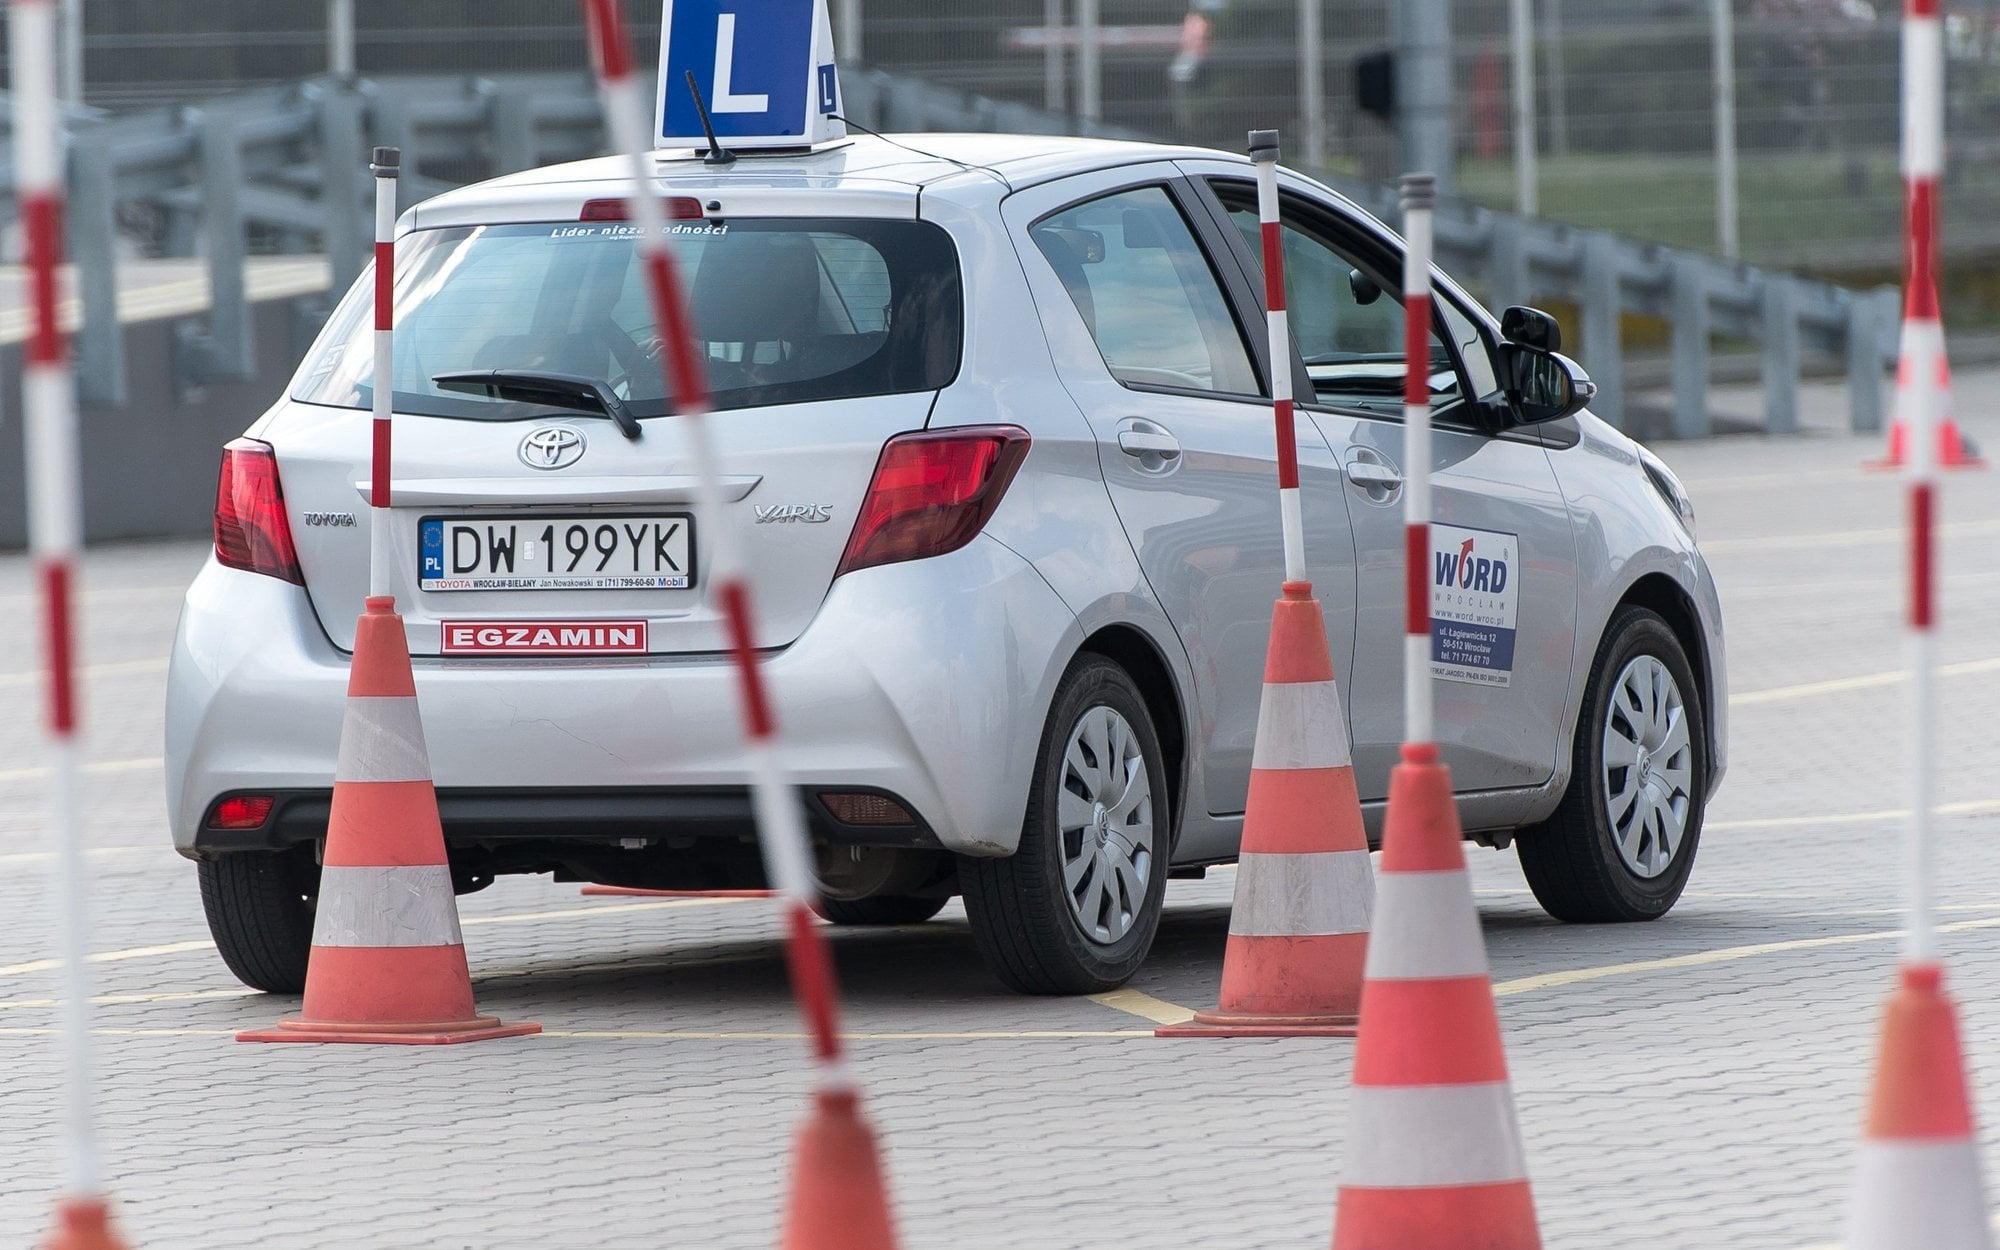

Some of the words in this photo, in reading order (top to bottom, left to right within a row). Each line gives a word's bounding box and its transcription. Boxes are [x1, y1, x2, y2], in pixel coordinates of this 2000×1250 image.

[711, 13, 769, 114] L
[822, 72, 832, 106] L
[550, 227, 596, 238] Lider
[600, 223, 729, 237] niezaodności
[303, 511, 358, 527] TOYOTA
[452, 525, 516, 574] DW
[541, 523, 680, 573] 199YK
[425, 557, 441, 571] PL
[1436, 551, 1507, 594] WORD
[435, 580, 471, 589] TOYOTA
[473, 579, 537, 588] WROCŁAW-BIELANY
[540, 579, 552, 588] Jan
[553, 578, 594, 587] Nowakowski
[604, 577, 619, 588] (71)
[658, 577, 684, 586] Mobil
[1435, 609, 1504, 626] www.word.wroc.pl
[452, 628, 637, 646] EGZAMIN
[1489, 633, 1497, 643] 12
